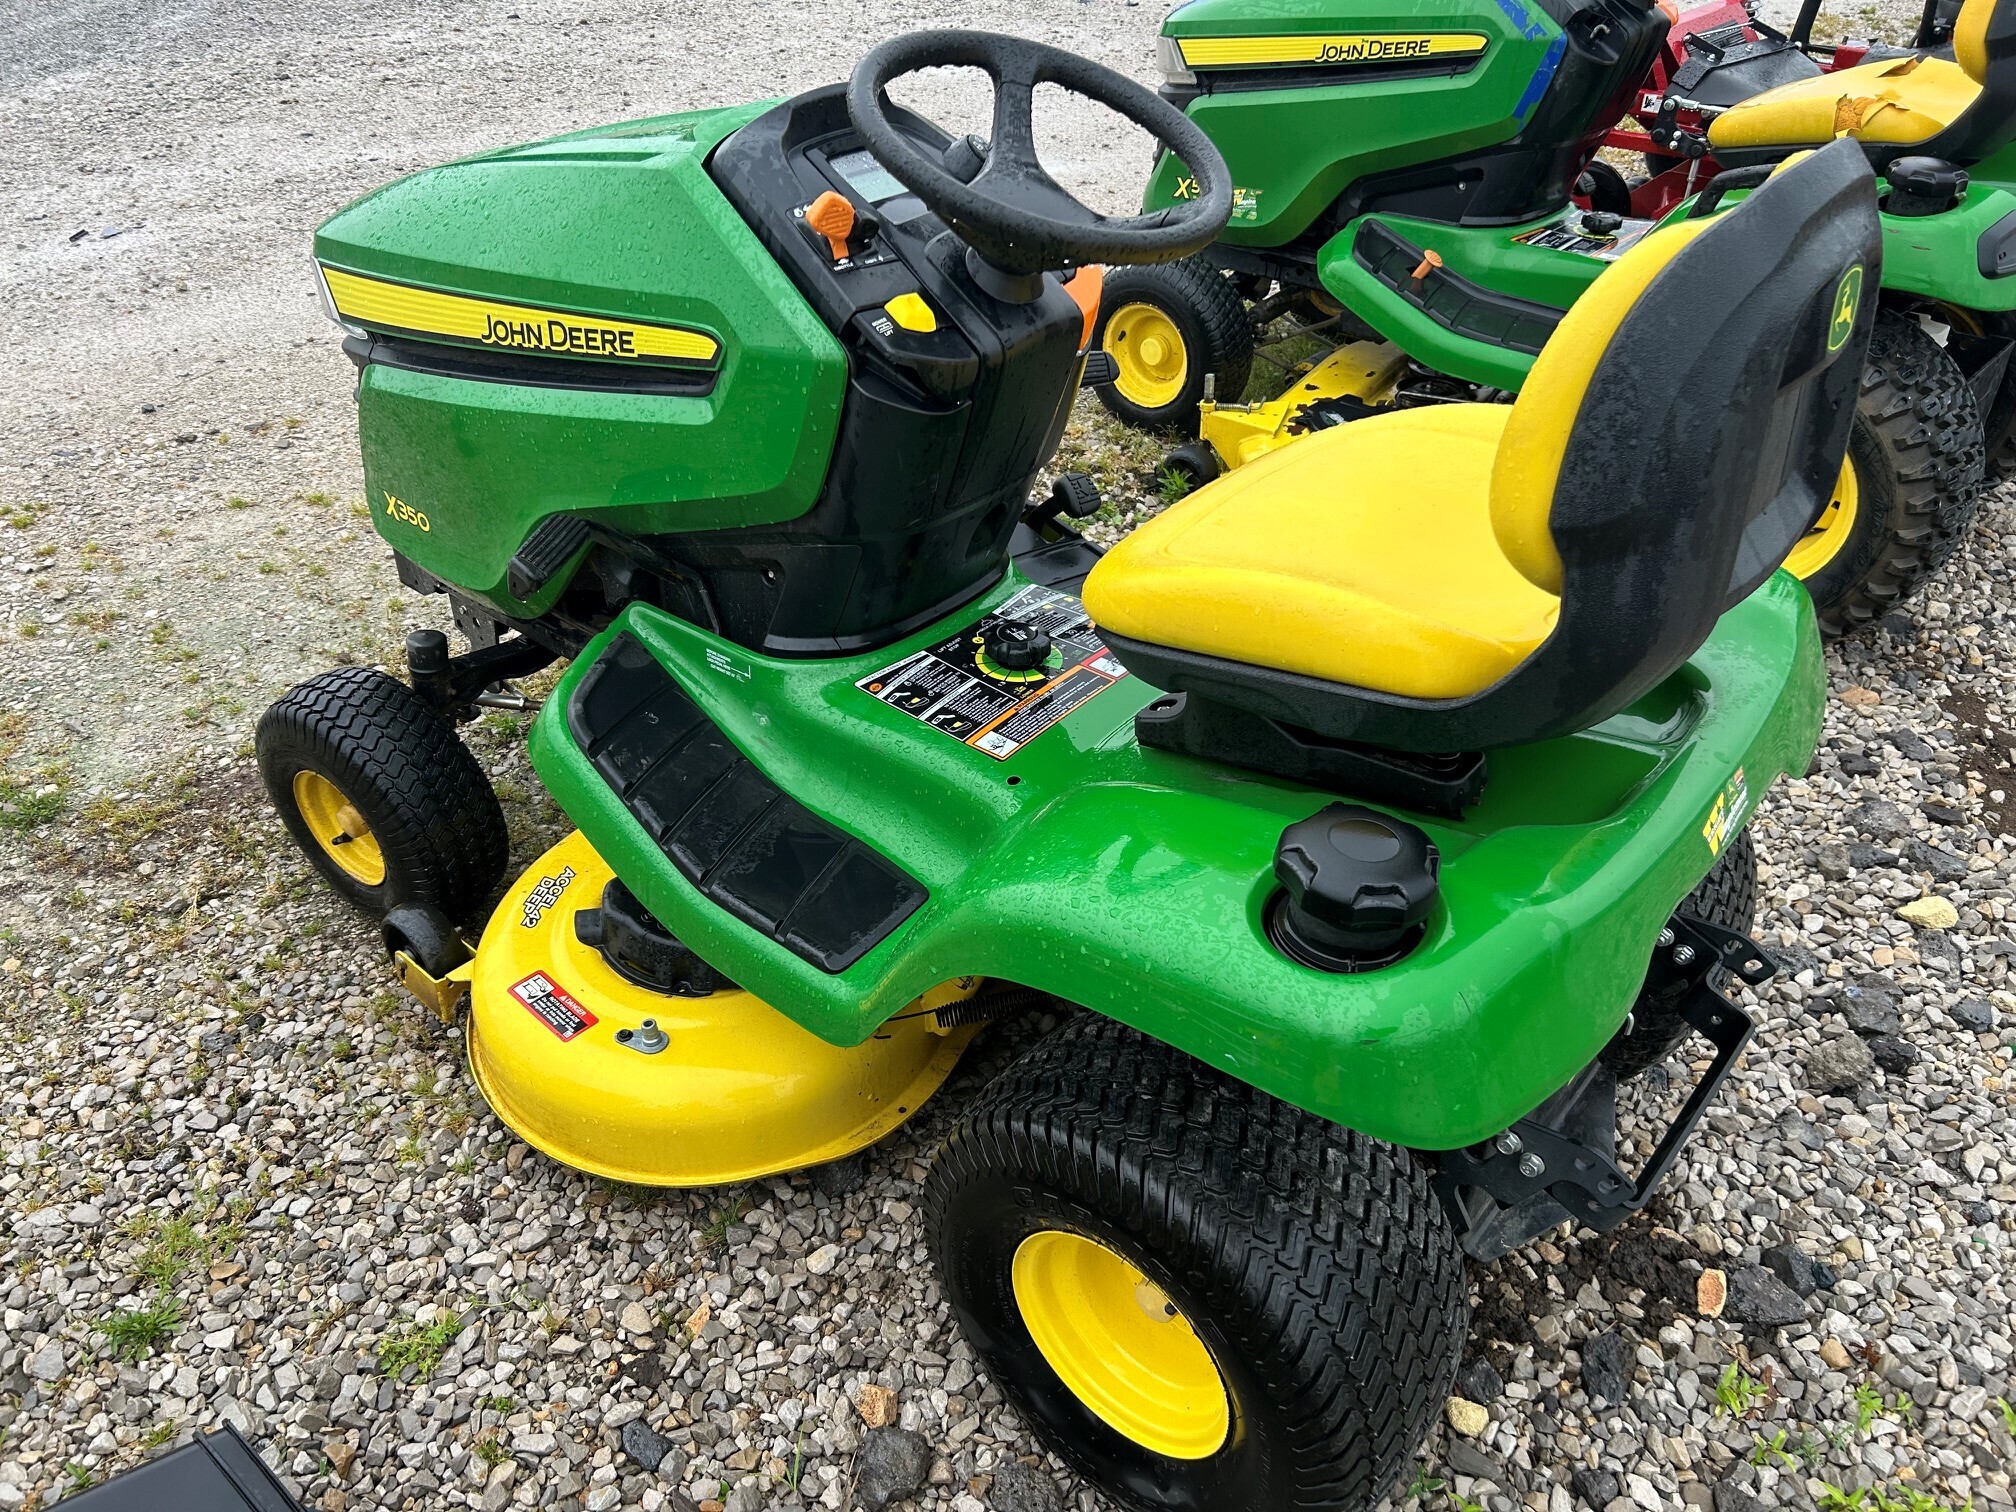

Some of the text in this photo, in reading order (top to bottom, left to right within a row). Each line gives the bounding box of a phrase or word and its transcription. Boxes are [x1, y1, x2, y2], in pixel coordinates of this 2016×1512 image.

[1314, 39, 1431, 61] JOHN DEERE
[481, 314, 637, 356] JOHN DEERE
[382, 489, 430, 532] X350
[523, 876, 556, 915] DEEP
[565, 998, 587, 1017] DANGER
